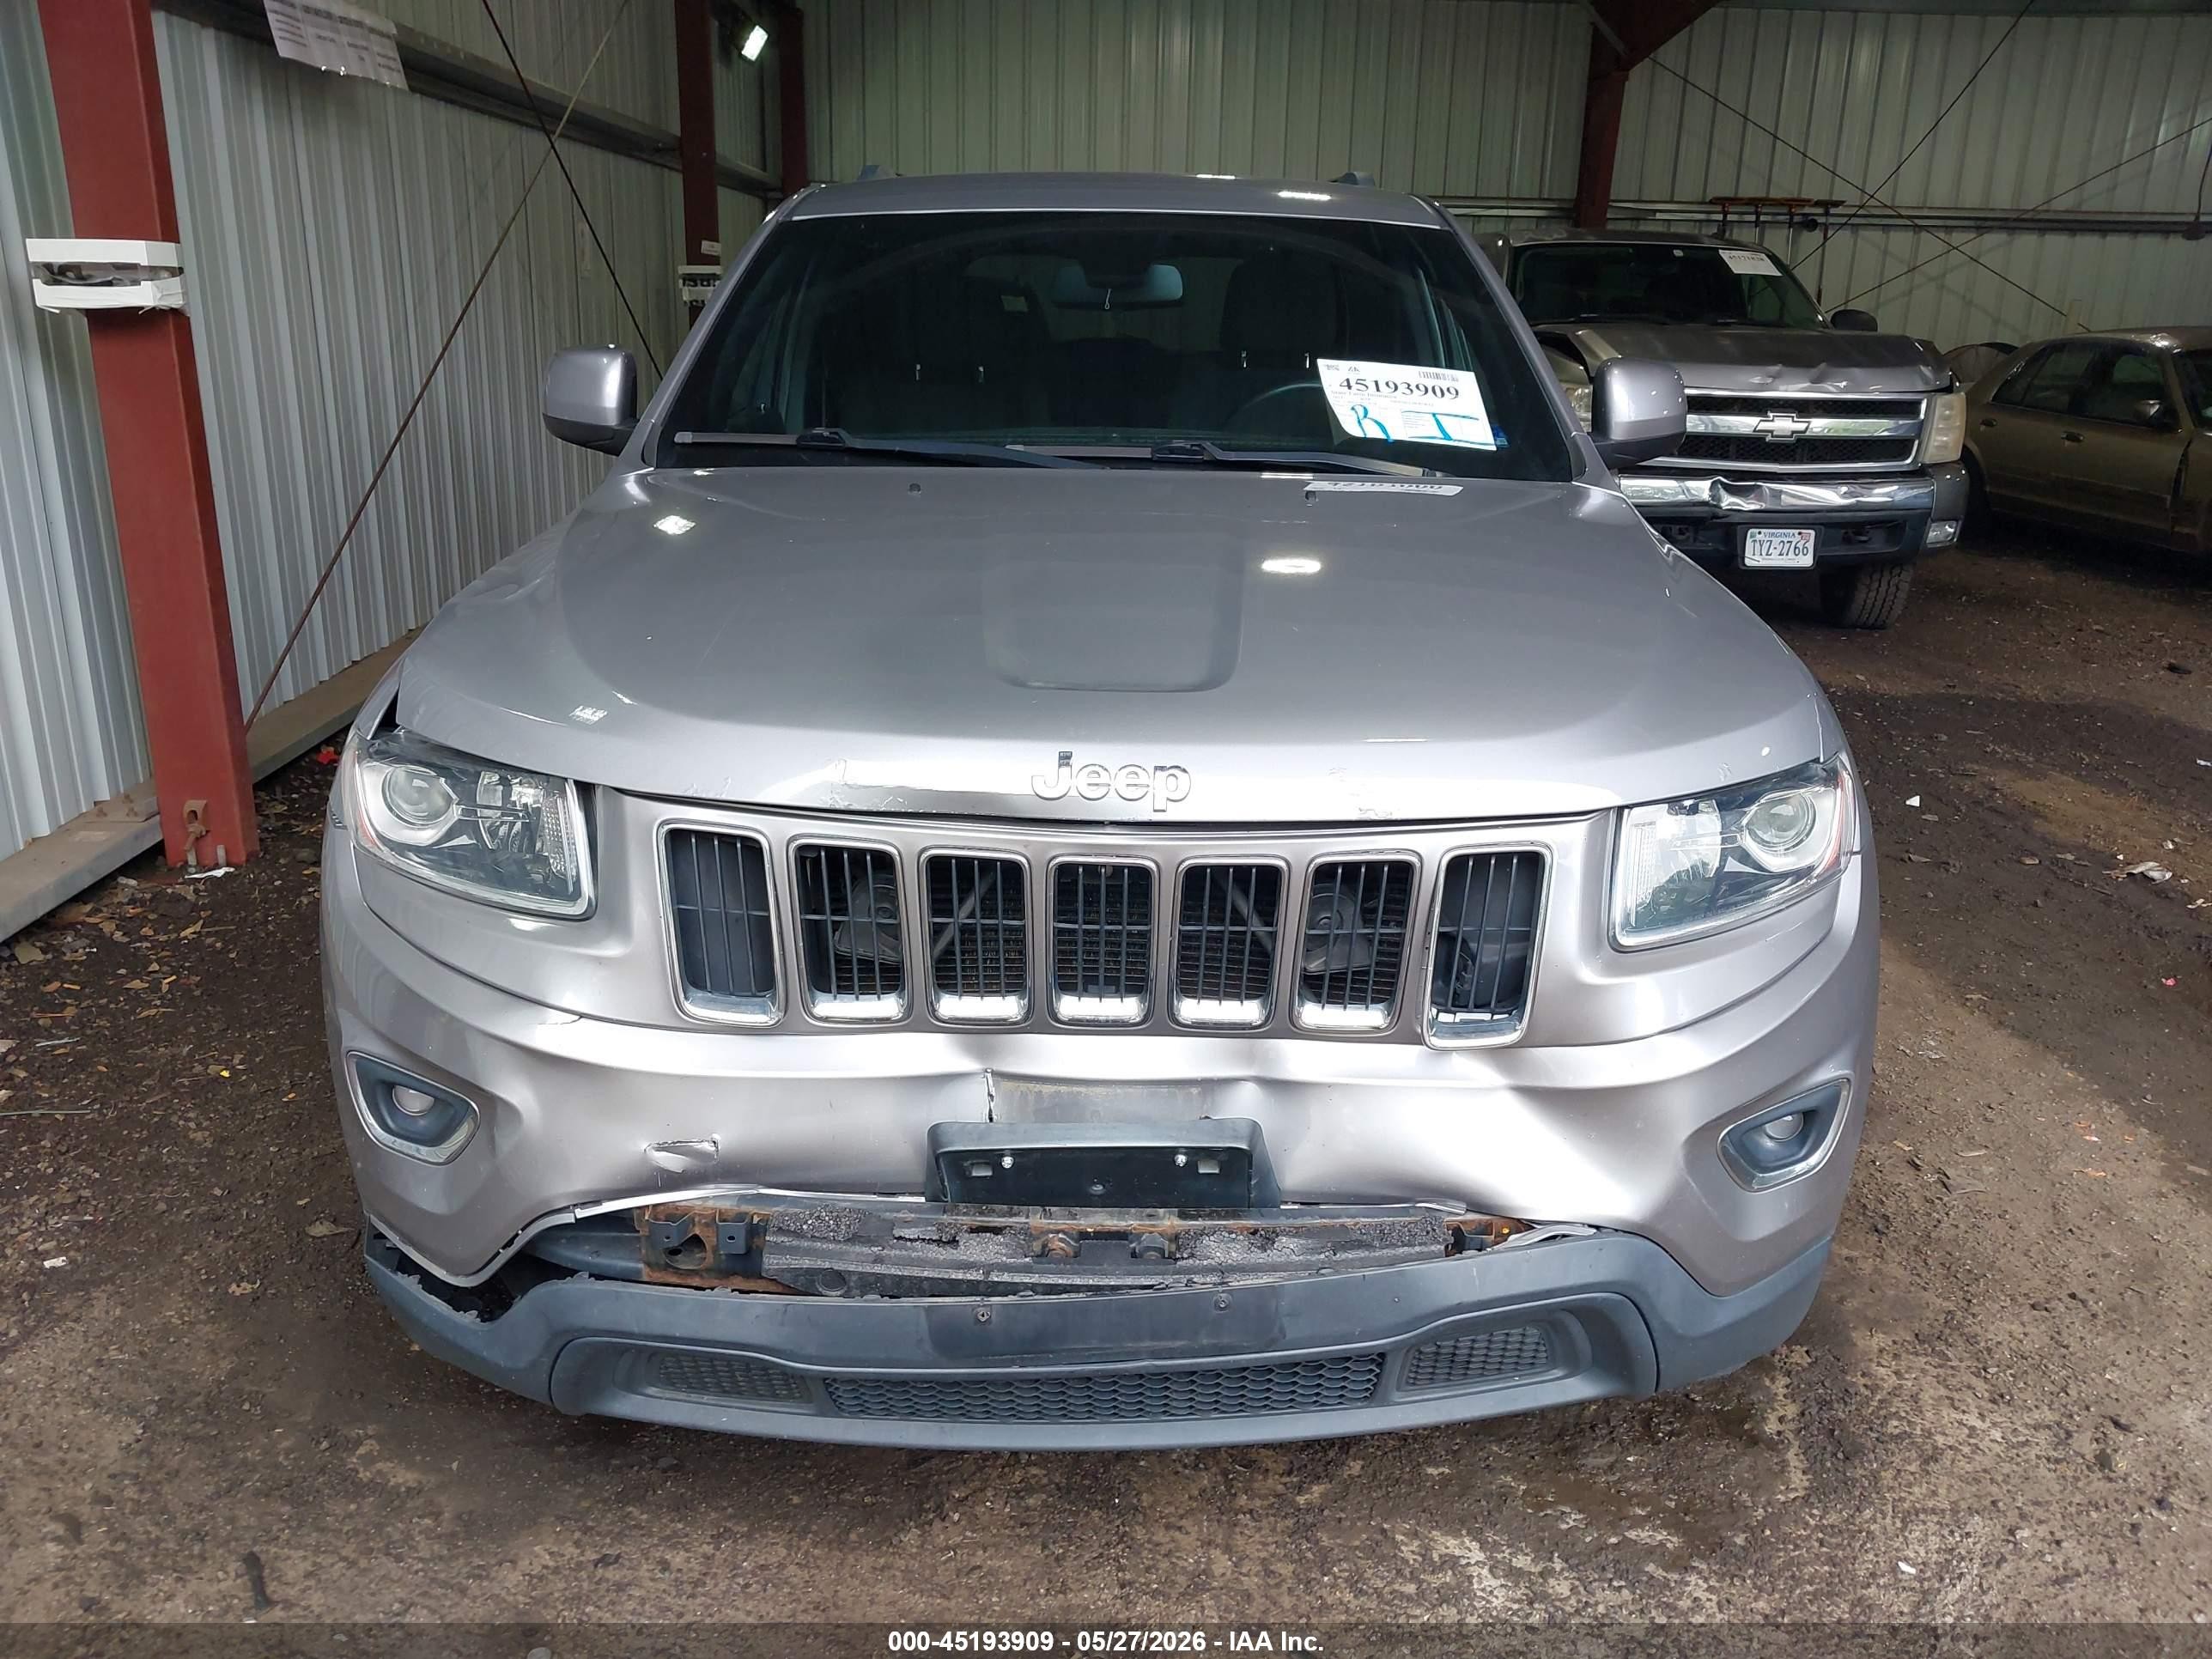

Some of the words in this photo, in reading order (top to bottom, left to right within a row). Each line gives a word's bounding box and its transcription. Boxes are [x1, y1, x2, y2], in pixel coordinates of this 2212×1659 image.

[1340, 377, 1460, 400] 45193909
[1750, 538, 1809, 556] TYZ-2766
[1031, 750, 1192, 813] Jeep
